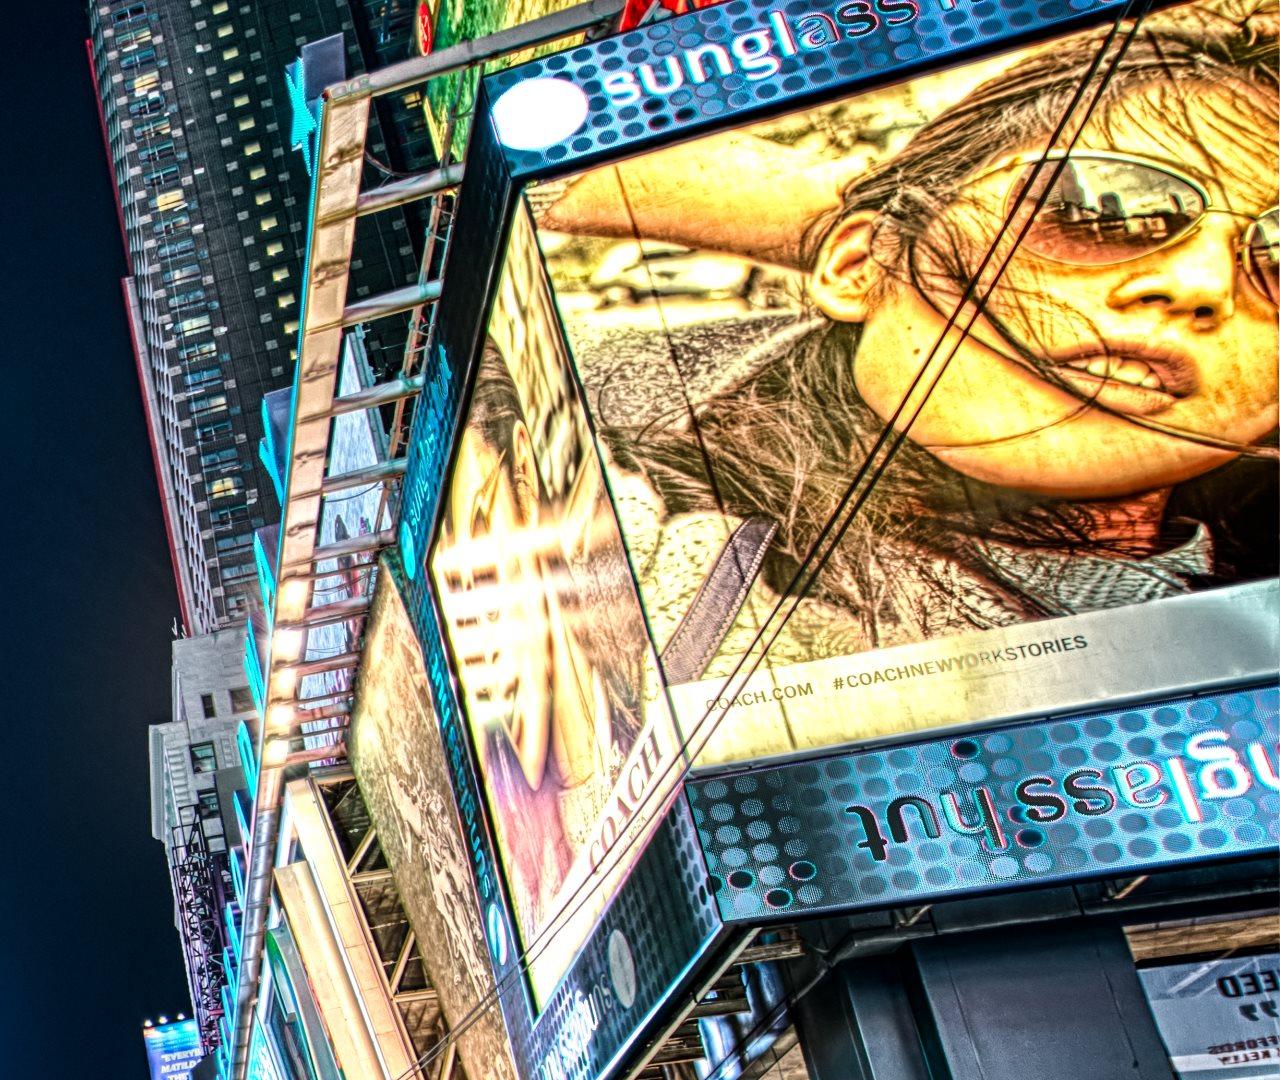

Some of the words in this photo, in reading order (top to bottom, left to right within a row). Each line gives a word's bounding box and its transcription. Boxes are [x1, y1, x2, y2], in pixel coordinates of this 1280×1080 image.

[833, 634, 1088, 690] #COACHNEWYORKSTORIES
[705, 682, 814, 713] COACH.COM
[588, 725, 664, 878] COACH
